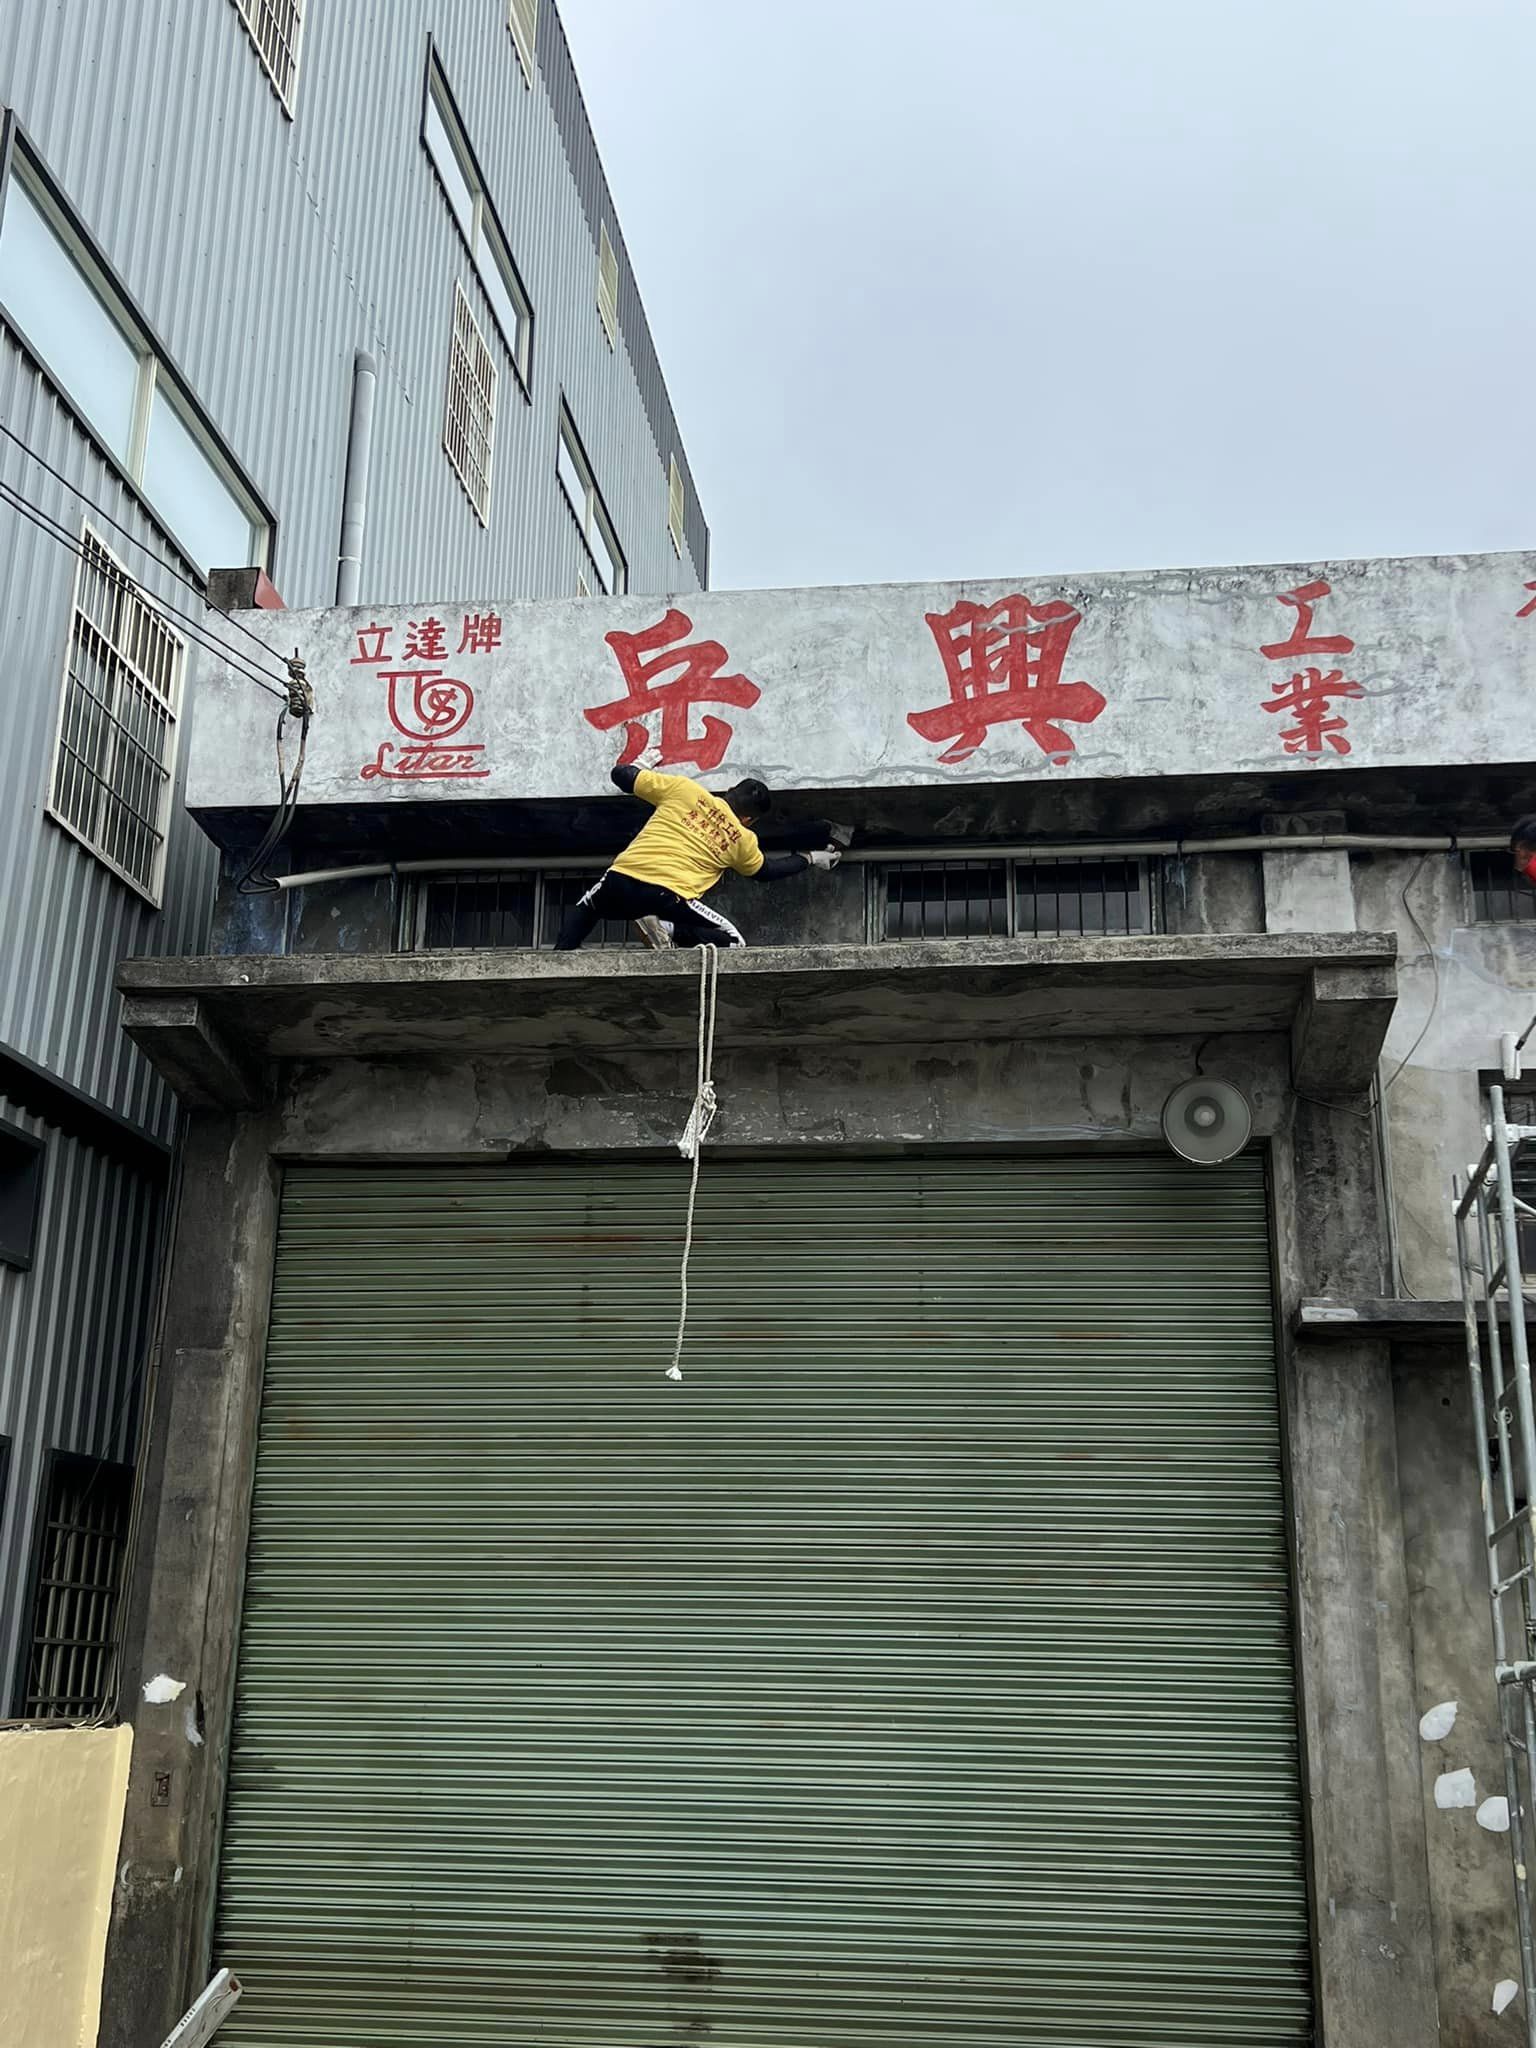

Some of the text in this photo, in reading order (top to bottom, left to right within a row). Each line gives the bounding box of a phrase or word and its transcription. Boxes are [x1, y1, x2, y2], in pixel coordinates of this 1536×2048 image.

[350, 612, 502, 665] 立達牌
[360, 742, 490, 780] Litar
